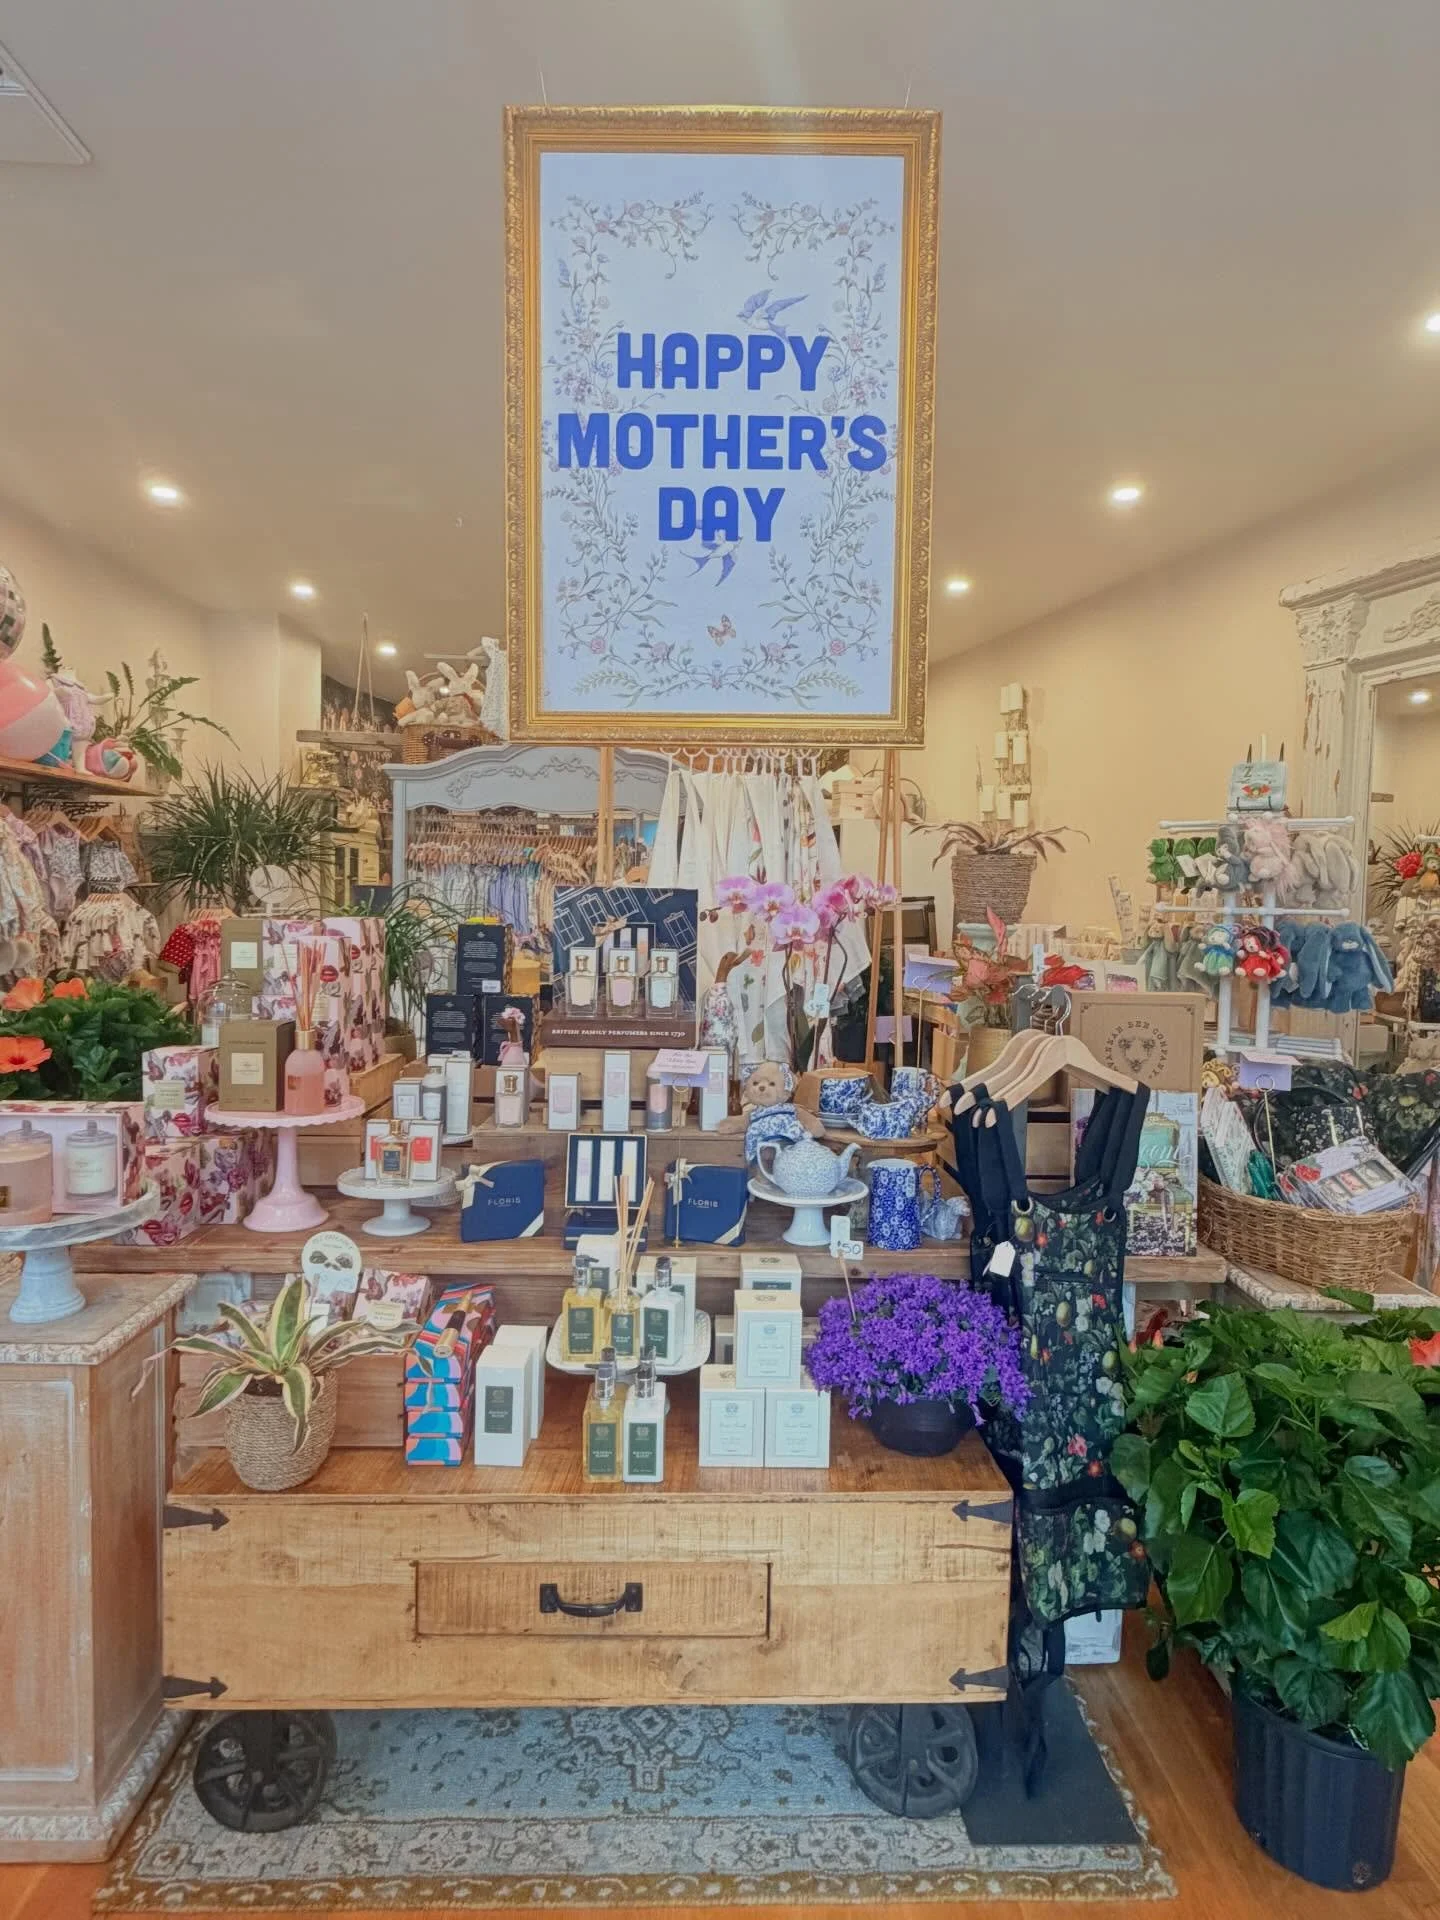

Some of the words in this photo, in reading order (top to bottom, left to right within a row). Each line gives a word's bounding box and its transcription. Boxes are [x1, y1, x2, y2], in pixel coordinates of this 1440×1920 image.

[617, 332, 828, 391] HAPPY
[558, 413, 887, 472] MOTHER'S
[657, 486, 786, 543] DAY
[551, 1028, 580, 1036] BRITISH
[581, 1029, 607, 1037] FAMILY
[607, 1029, 649, 1037] PERFUMERS
[670, 1030, 686, 1039] 1730
[487, 1196, 521, 1206] FLORIS
[687, 1197, 720, 1208] FLORIS
